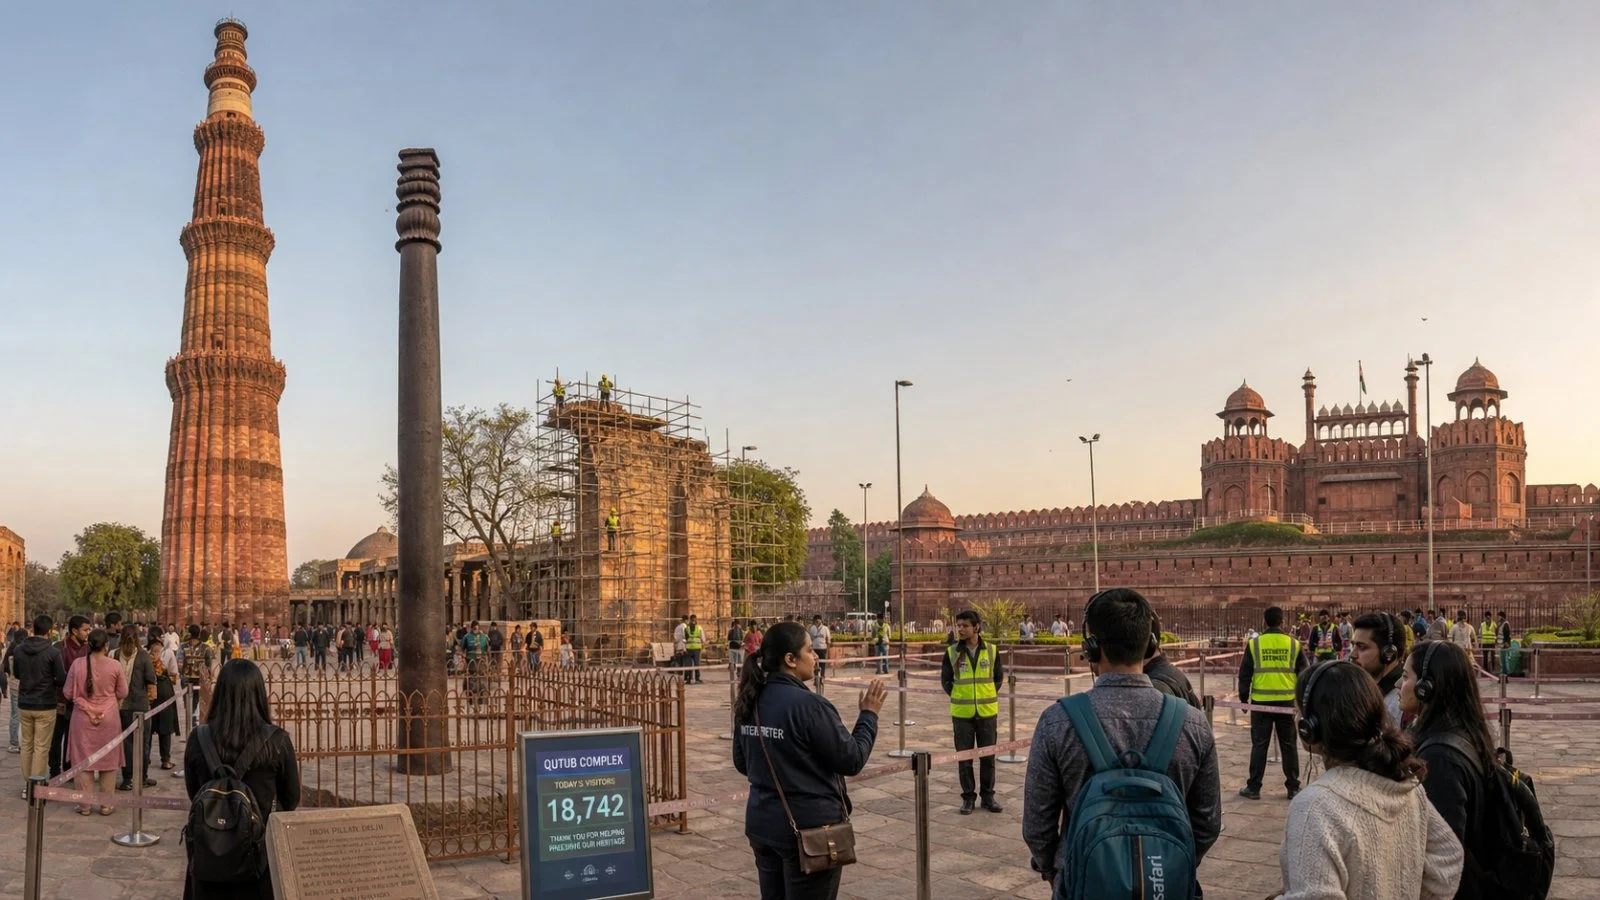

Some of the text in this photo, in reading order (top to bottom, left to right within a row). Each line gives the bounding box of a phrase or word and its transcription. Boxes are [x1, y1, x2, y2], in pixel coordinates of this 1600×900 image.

[544, 755, 623, 771] QUTUB COMPLEX
[554, 777, 616, 789] TODAY'S VISITORS
[547, 793, 625, 825] 18,742
[573, 833, 586, 841] YOU
[586, 831, 599, 839] FOR
[599, 829, 625, 837] HELPING
[581, 841, 596, 849] OUR
[1147, 855, 1165, 900] safari
